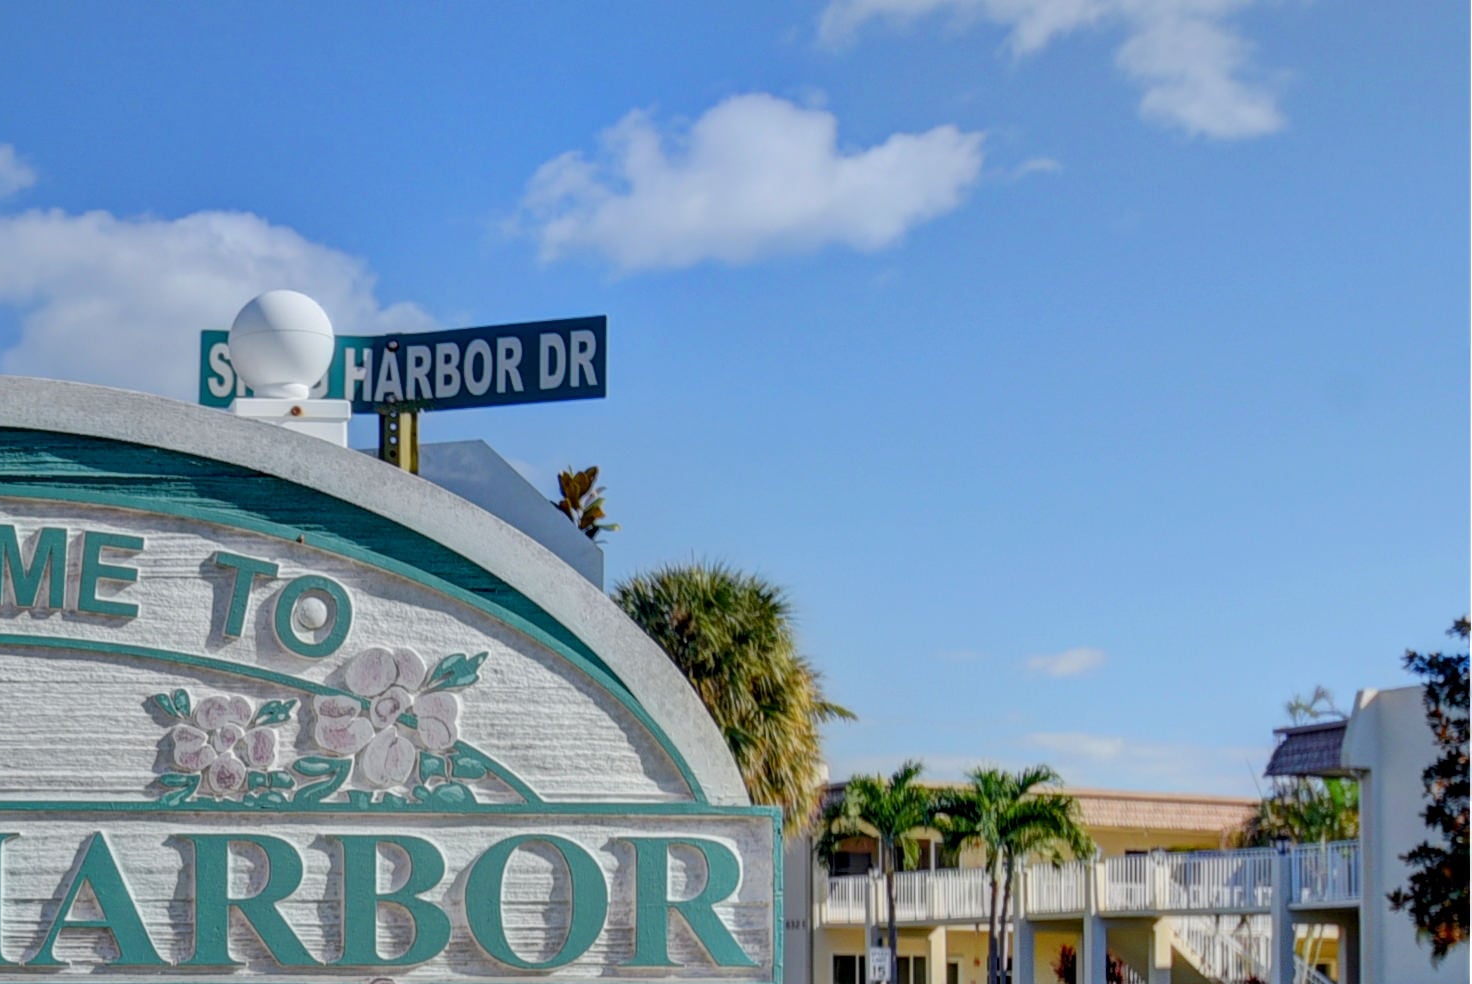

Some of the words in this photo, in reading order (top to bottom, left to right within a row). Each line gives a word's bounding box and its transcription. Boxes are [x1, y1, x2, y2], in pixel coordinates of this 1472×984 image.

[344, 335, 524, 402] HARBOR
[539, 330, 597, 390] DR
[210, 550, 352, 658] TO
